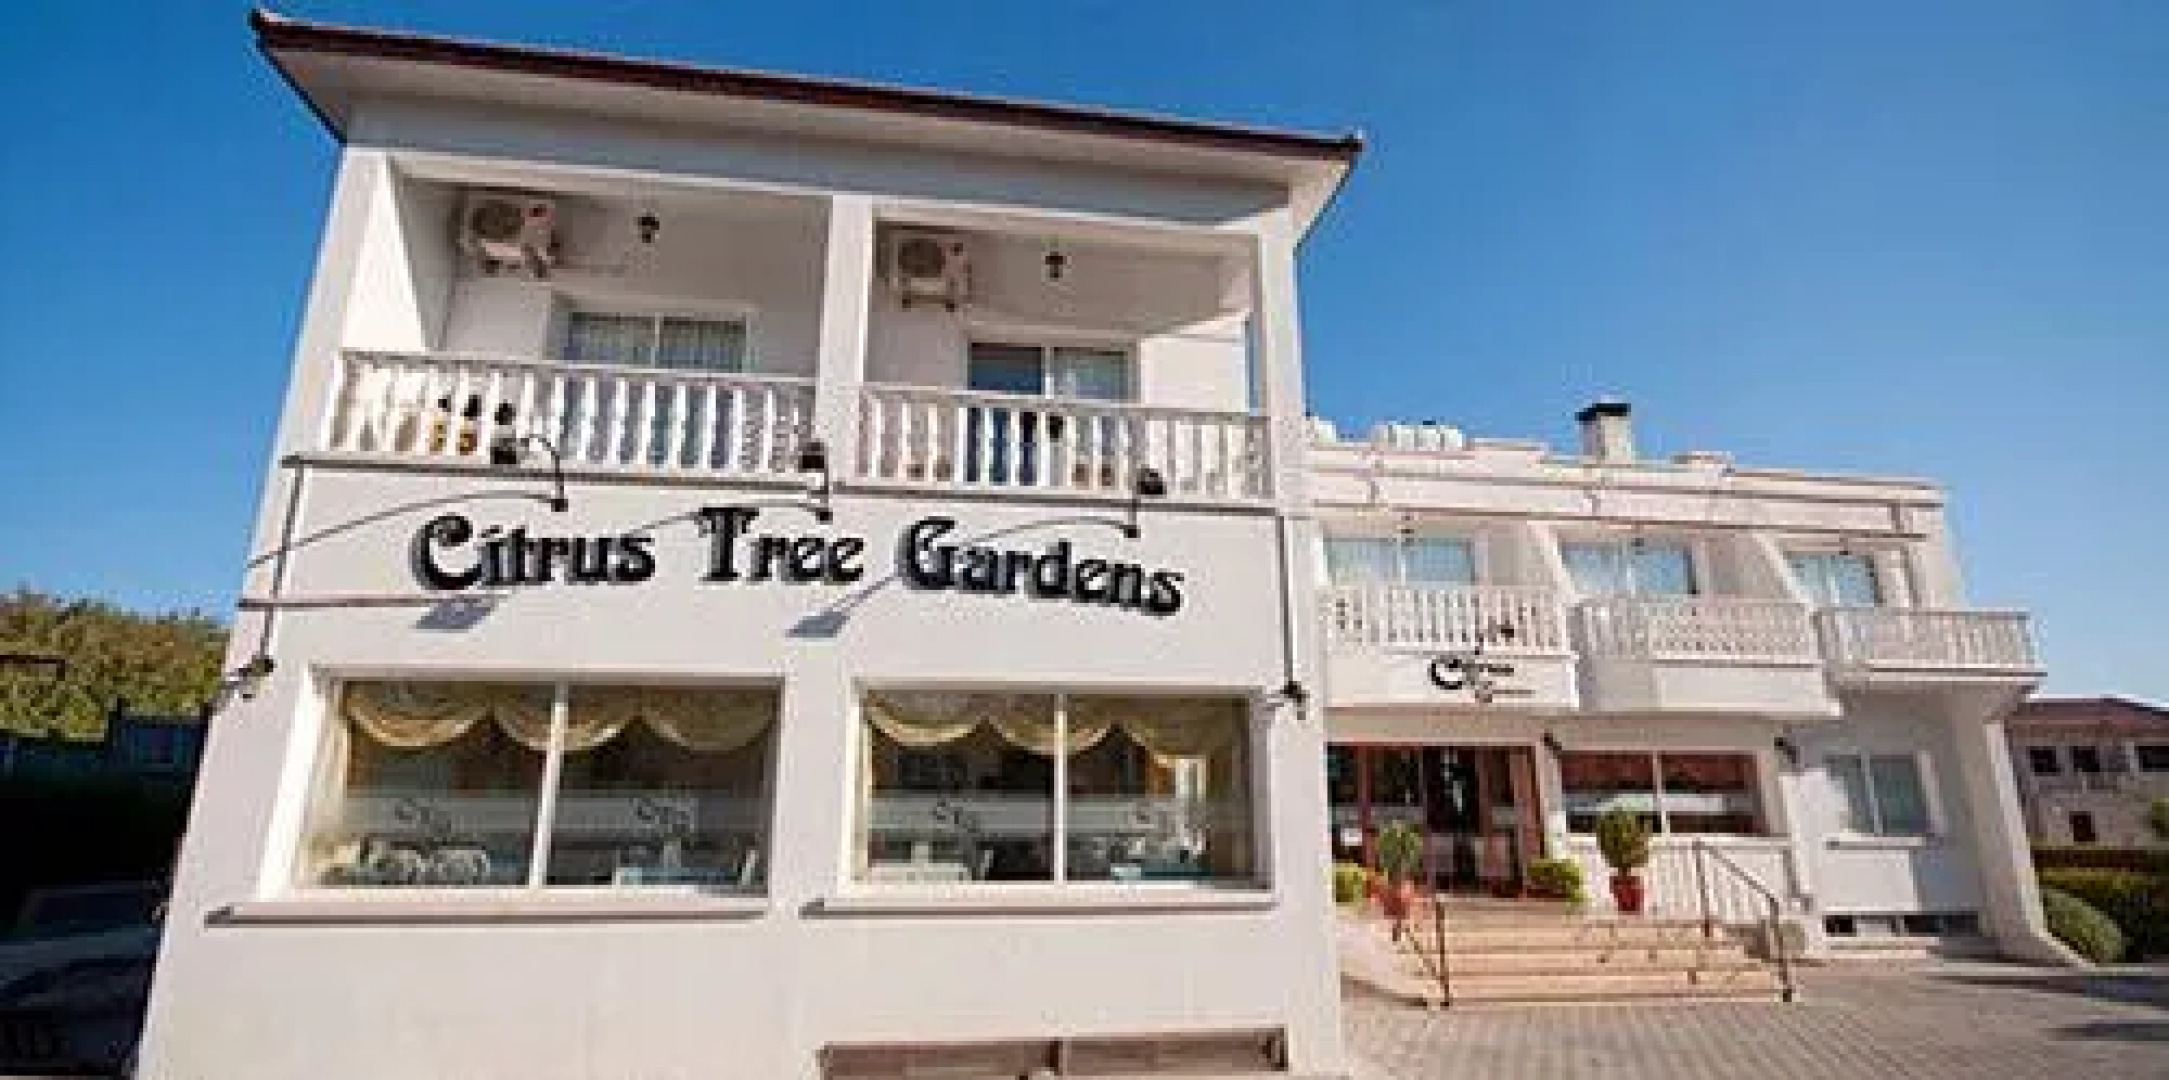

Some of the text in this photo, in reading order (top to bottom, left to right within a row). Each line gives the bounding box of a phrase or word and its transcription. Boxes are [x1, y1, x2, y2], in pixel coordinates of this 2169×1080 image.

[413, 504, 1184, 617] Citrus Tree Gardens
